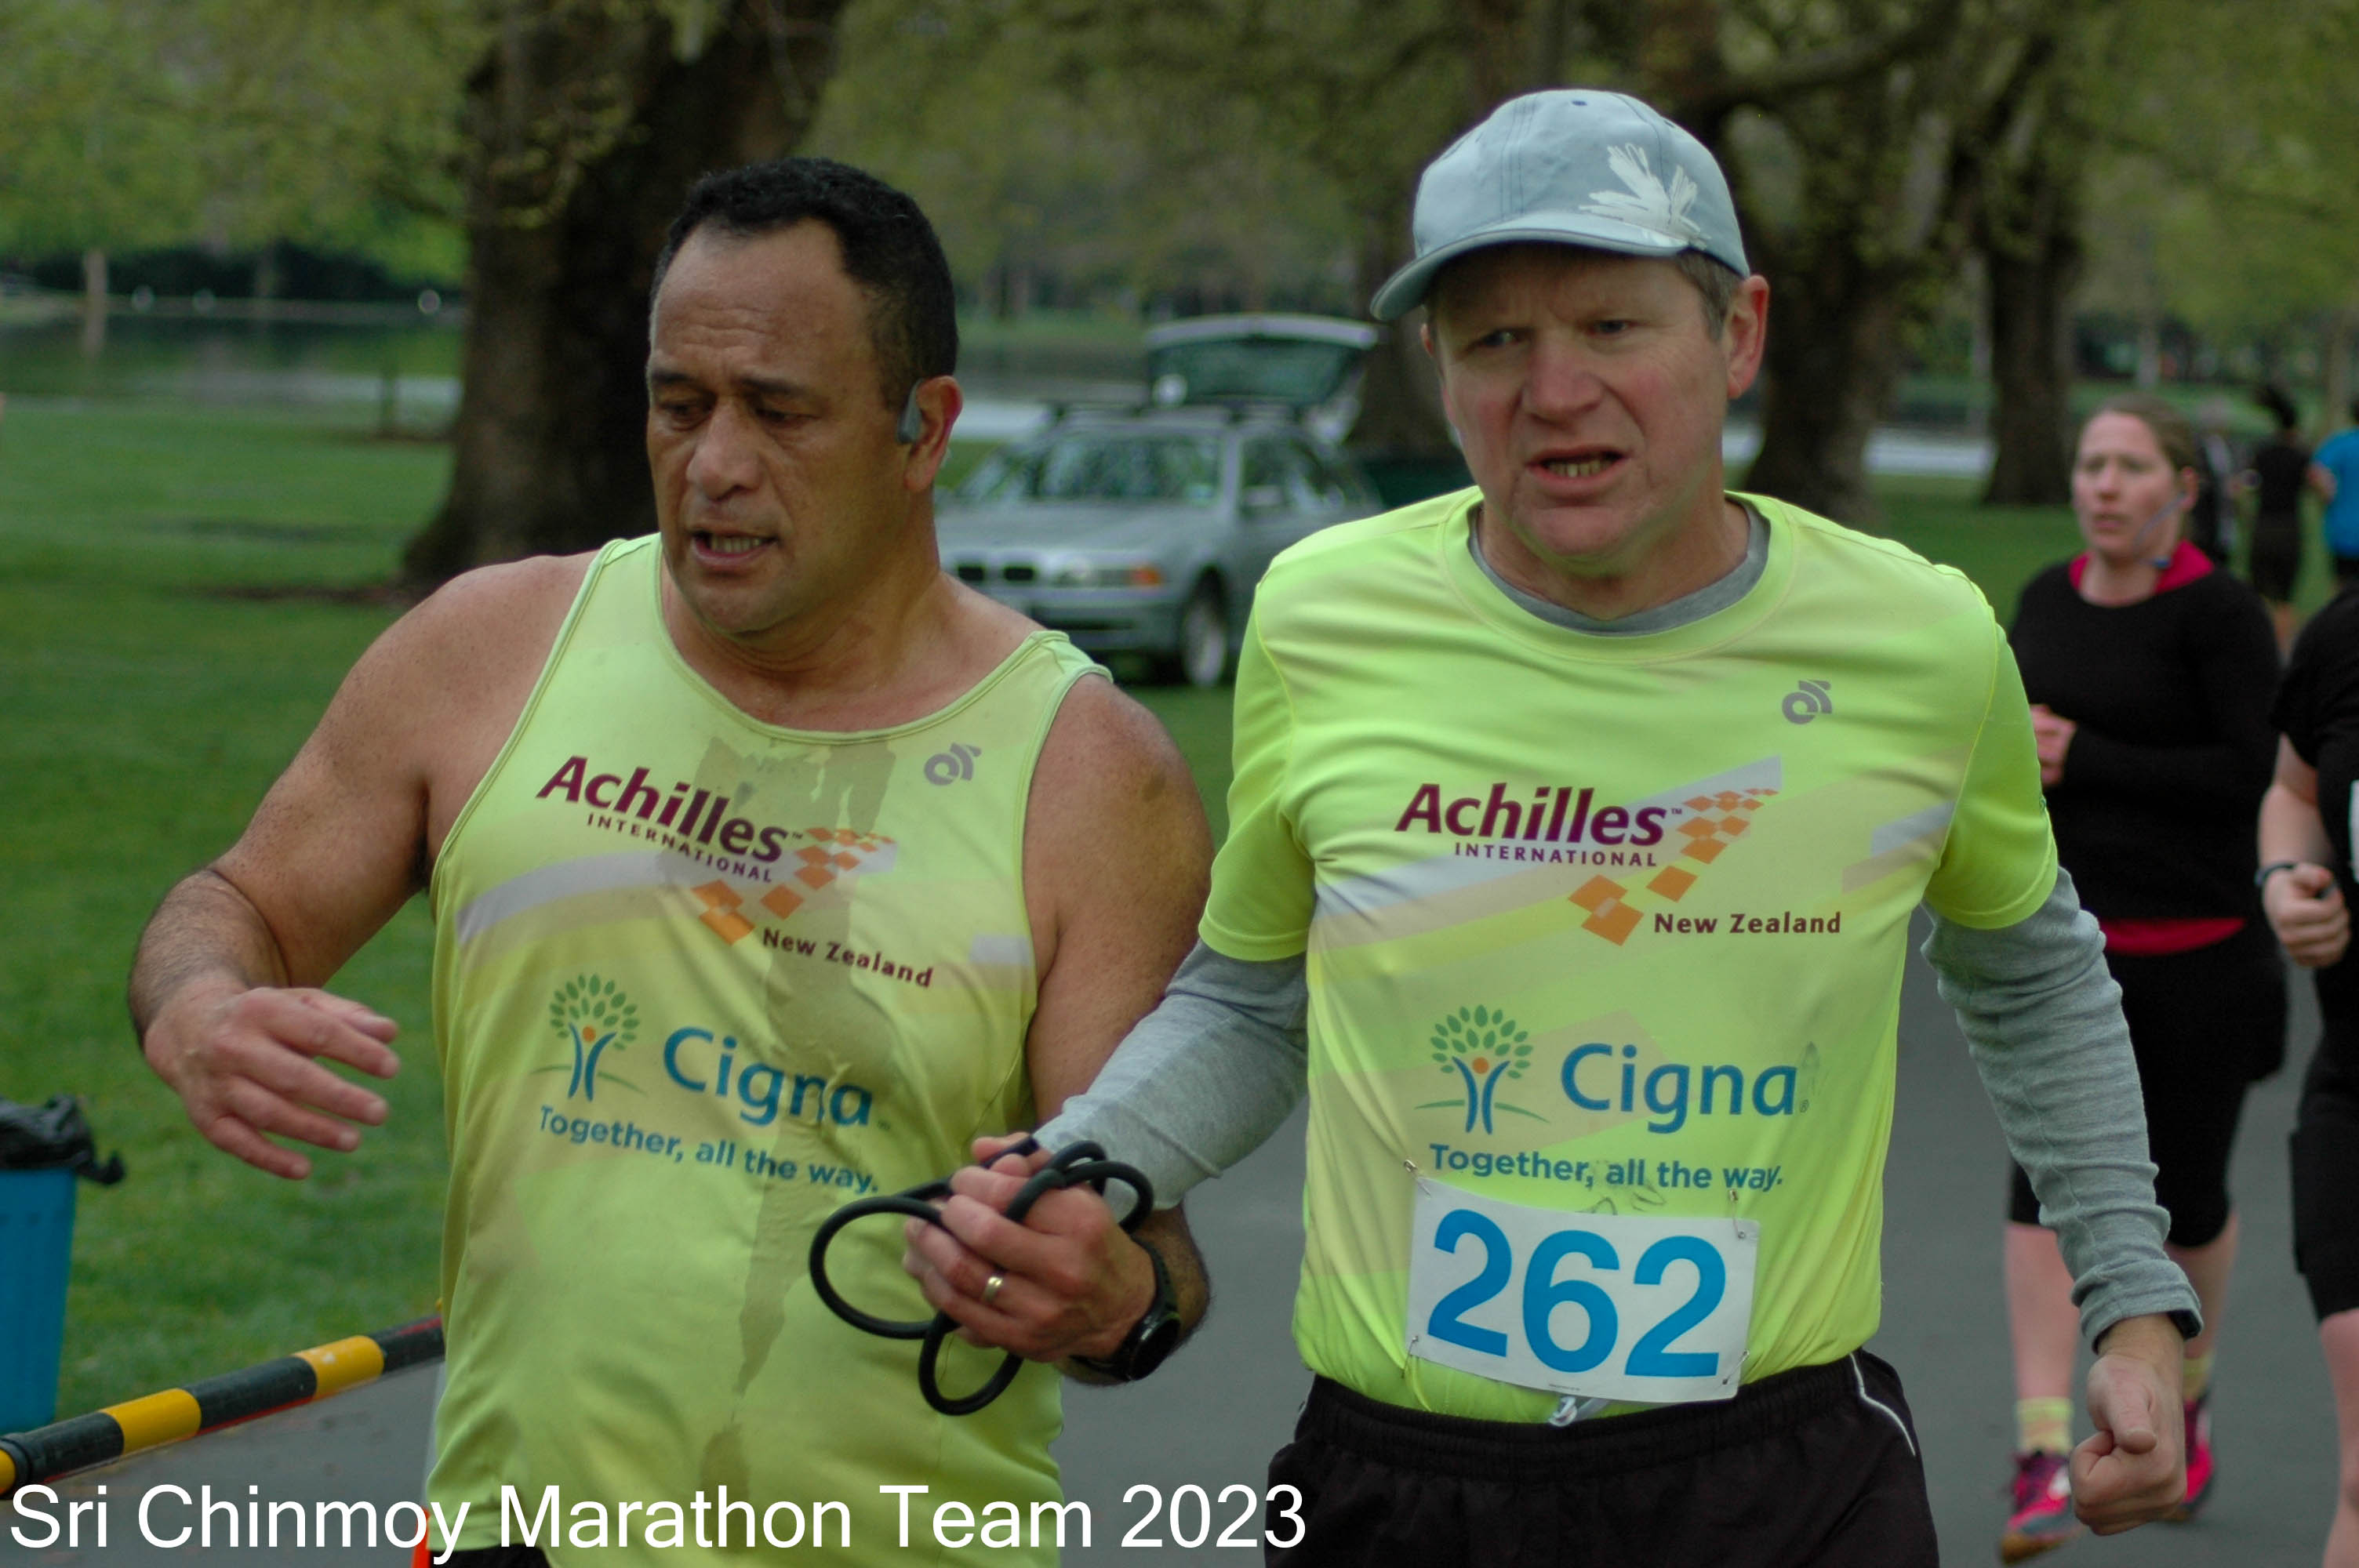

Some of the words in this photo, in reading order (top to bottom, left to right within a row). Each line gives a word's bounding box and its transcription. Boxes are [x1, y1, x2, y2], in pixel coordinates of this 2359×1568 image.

[536, 756, 790, 863] Achilles
[1395, 782, 1667, 846] Achilles
[587, 813, 773, 883] INTERNATIONAL
[1455, 842, 1657, 867] INTERNATIONAL
[762, 927, 817, 956] New
[827, 942, 933, 988] Zealand
[1654, 913, 1717, 934] New
[1729, 911, 1841, 934] Zealand
[663, 1026, 874, 1127] Cigna
[1561, 1043, 1798, 1134] Cigna
[540, 1105, 684, 1163] Together,
[696, 1141, 735, 1167] all
[744, 1150, 798, 1182] the
[809, 1163, 878, 1194] way.
[1430, 1143, 1594, 1187] Together,
[1605, 1159, 1645, 1186] all
[1657, 1160, 1712, 1189] the
[1722, 1164, 1783, 1192] way.
[1427, 1208, 1726, 1377] 262
